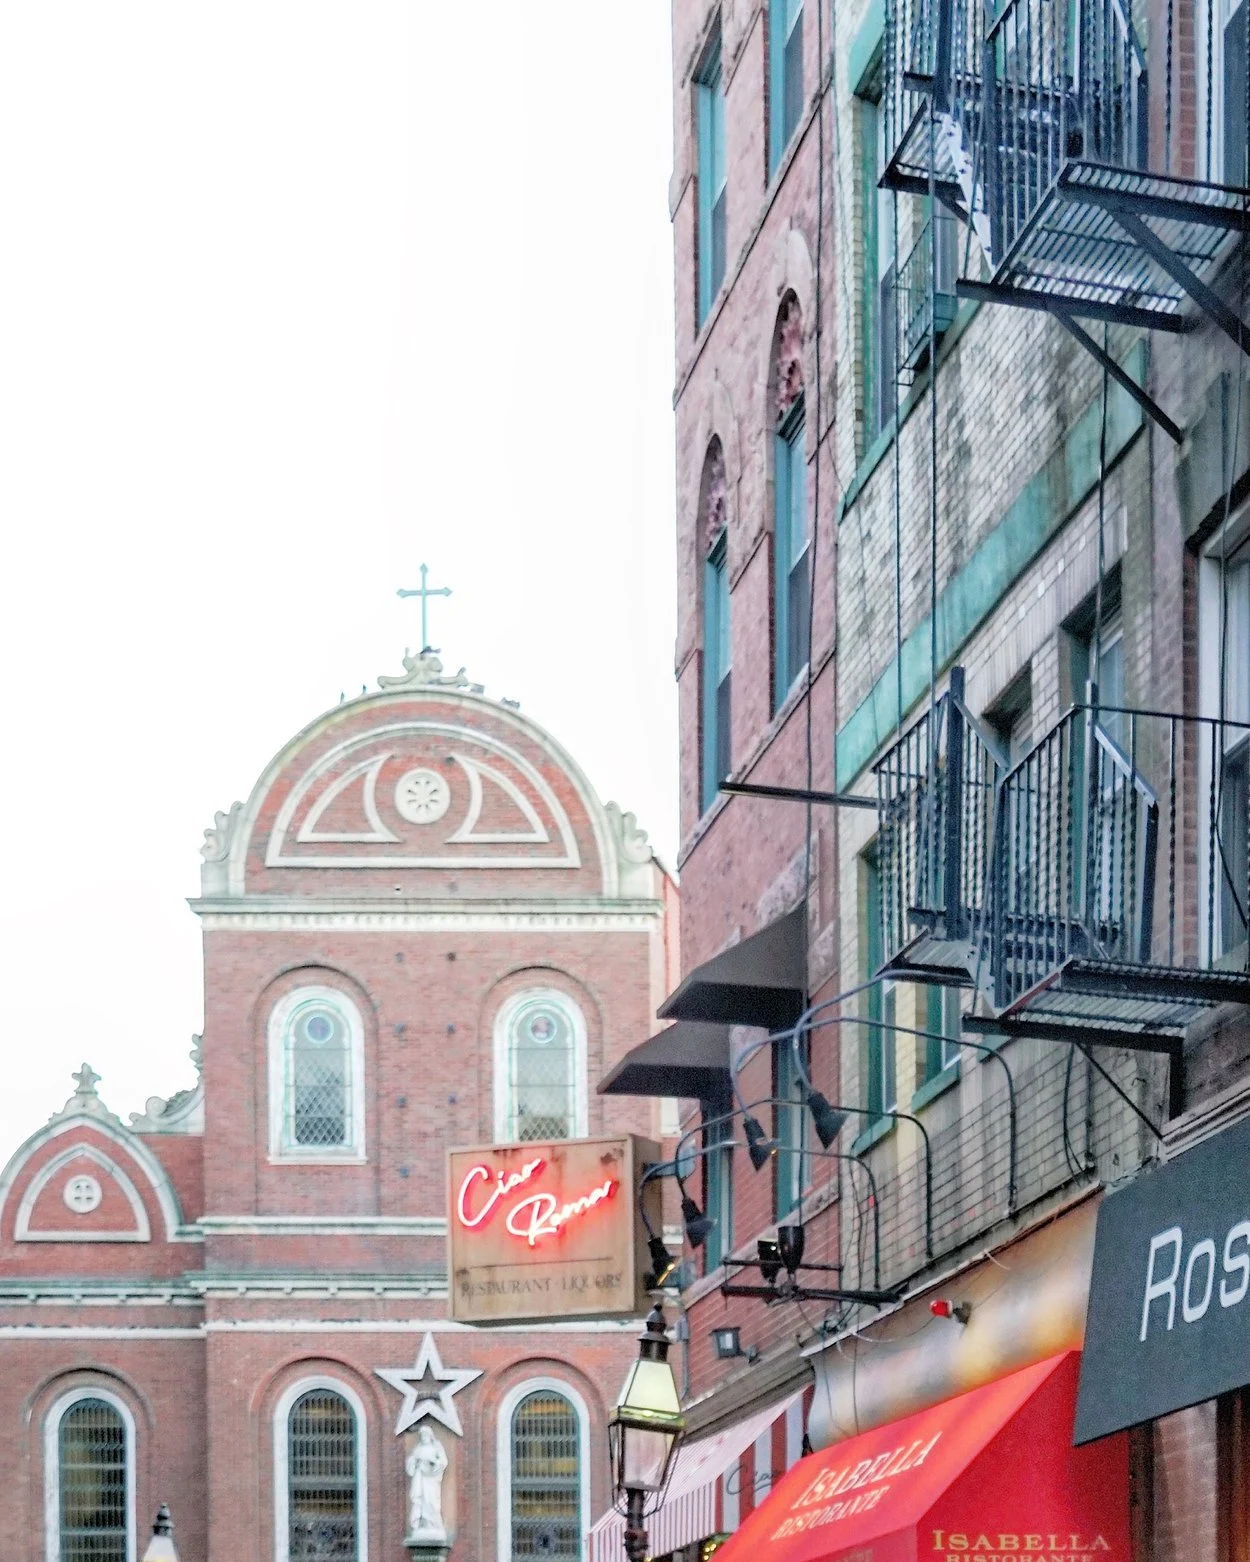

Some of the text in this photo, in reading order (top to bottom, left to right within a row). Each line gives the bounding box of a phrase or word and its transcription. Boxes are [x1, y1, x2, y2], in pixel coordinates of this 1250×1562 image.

[457, 1157, 544, 1228] Ciao
[505, 1179, 613, 1247] Roma
[460, 1277, 551, 1298] RESTAURANT
[791, 1431, 943, 1511] ISABELLA
[770, 1485, 892, 1541] RISTORANTE
[932, 1529, 1112, 1551] ISABELLA
